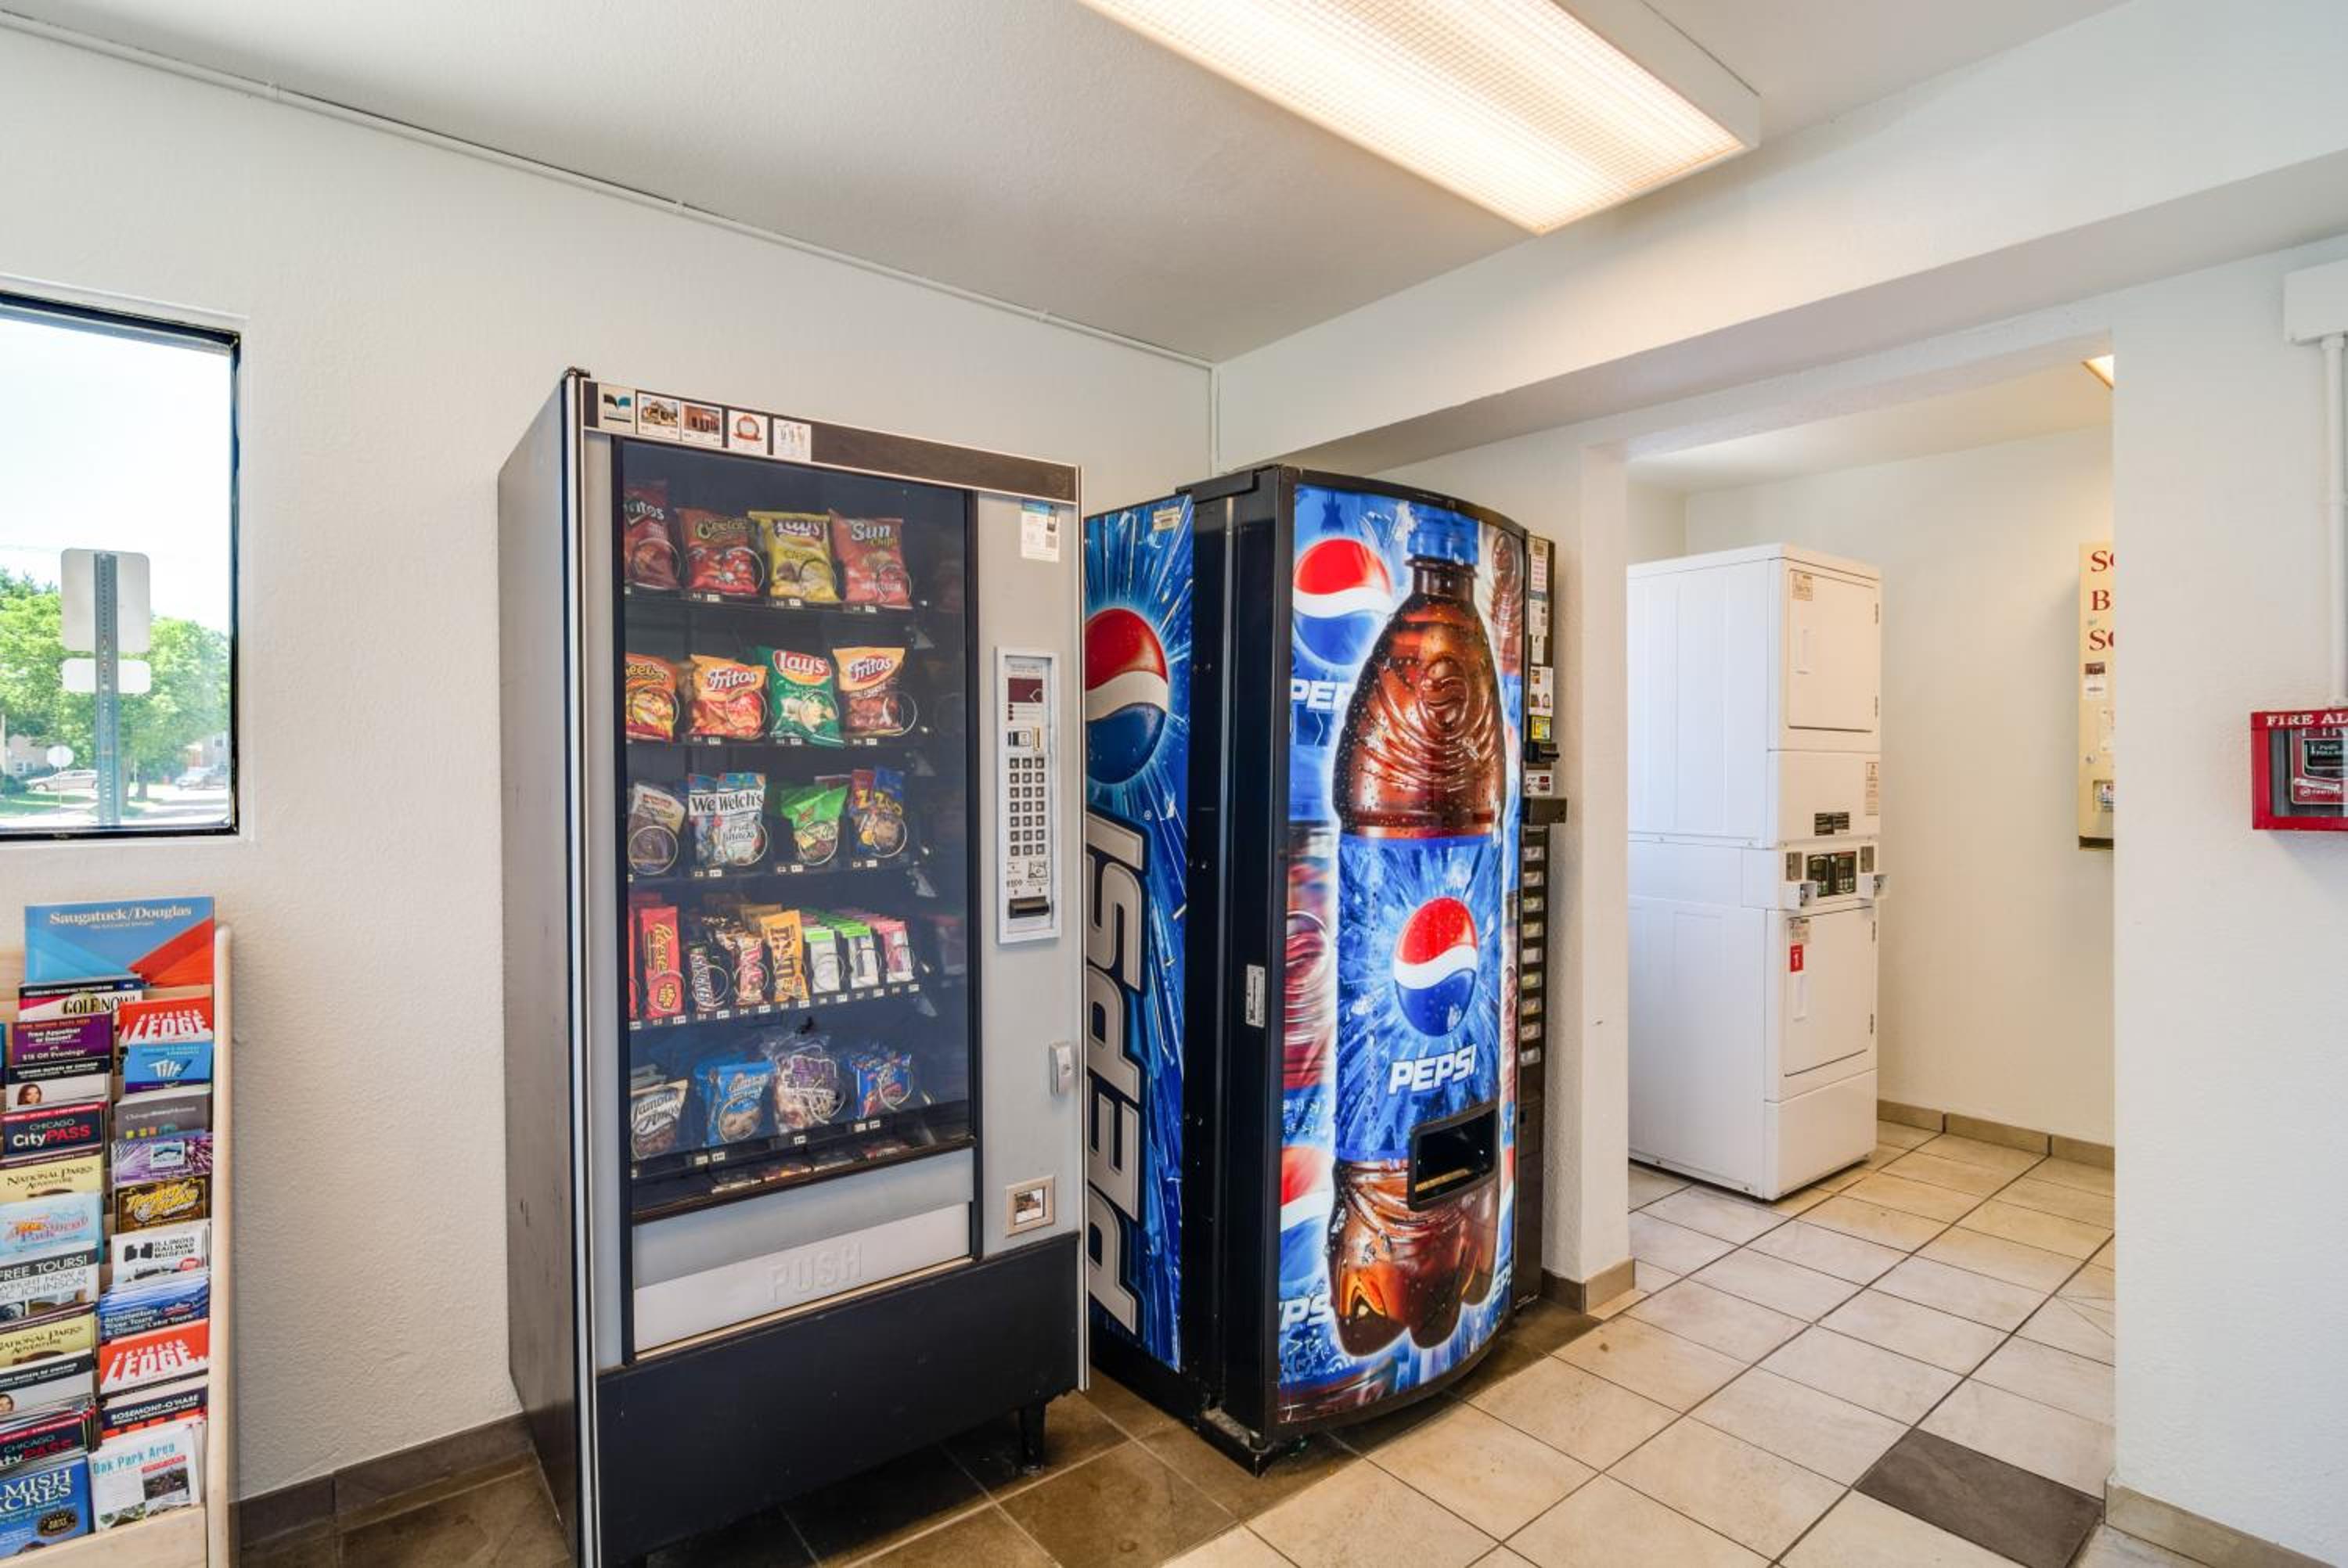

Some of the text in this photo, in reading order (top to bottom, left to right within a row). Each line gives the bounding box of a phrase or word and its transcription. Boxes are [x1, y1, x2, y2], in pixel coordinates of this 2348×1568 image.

[851, 523, 891, 541] Sun
[2091, 550, 2114, 572] S
[708, 669, 756, 689] Fritos
[848, 656, 892, 682] Fritos
[2267, 714, 2314, 726] FIRE
[719, 792, 764, 811] Welch's
[49, 905, 193, 926] Saugatuck/Douglas
[1086, 811, 1143, 1335] PEPSI
[1388, 1044, 1477, 1094] PEPSI
[30, 1117, 76, 1131] CHICAGO
[13, 1124, 92, 1149] CityPASS
[36, 1254, 88, 1273] TOURS!
[765, 1242, 862, 1303] PUSH
[93, 1461, 113, 1475] Oak
[118, 1451, 144, 1467] Park
[149, 1442, 176, 1459] Area
[0, 1469, 72, 1500] MISH
